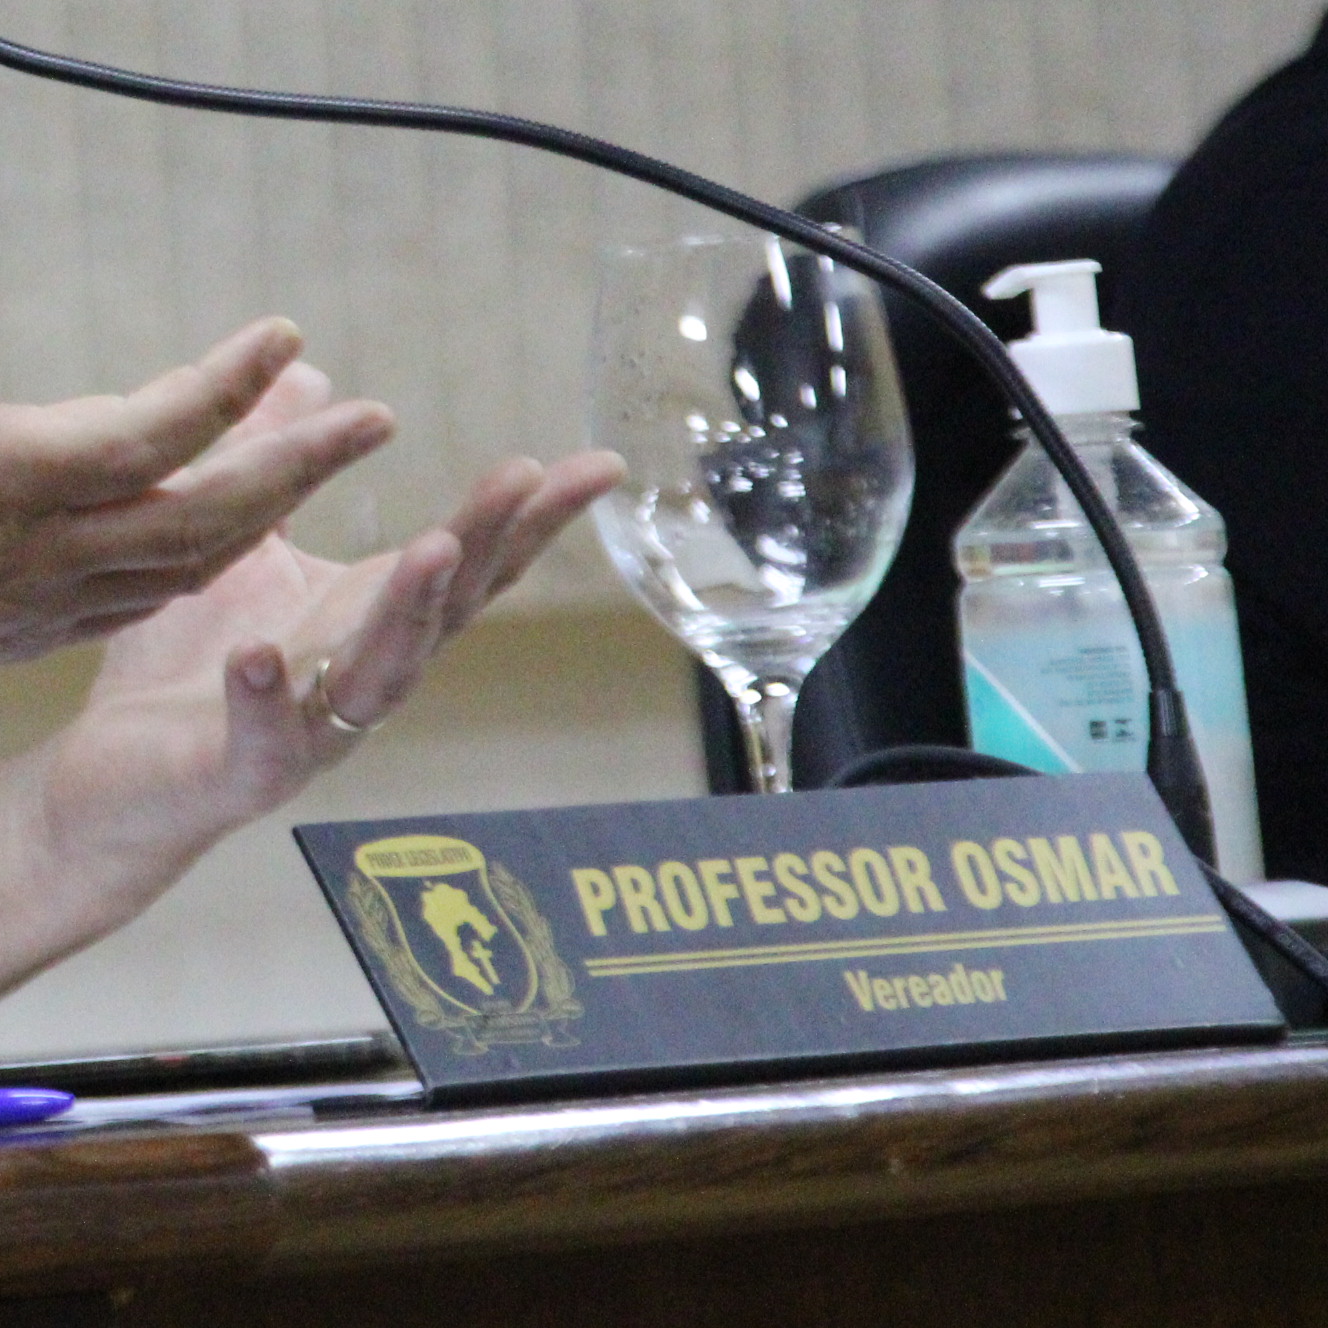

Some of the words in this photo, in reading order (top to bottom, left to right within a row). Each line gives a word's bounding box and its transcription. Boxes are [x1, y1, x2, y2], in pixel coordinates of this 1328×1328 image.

[572, 845, 946, 936] PROFESSOR
[951, 830, 1181, 911] OSMAR
[844, 963, 1007, 1012] Vereador
